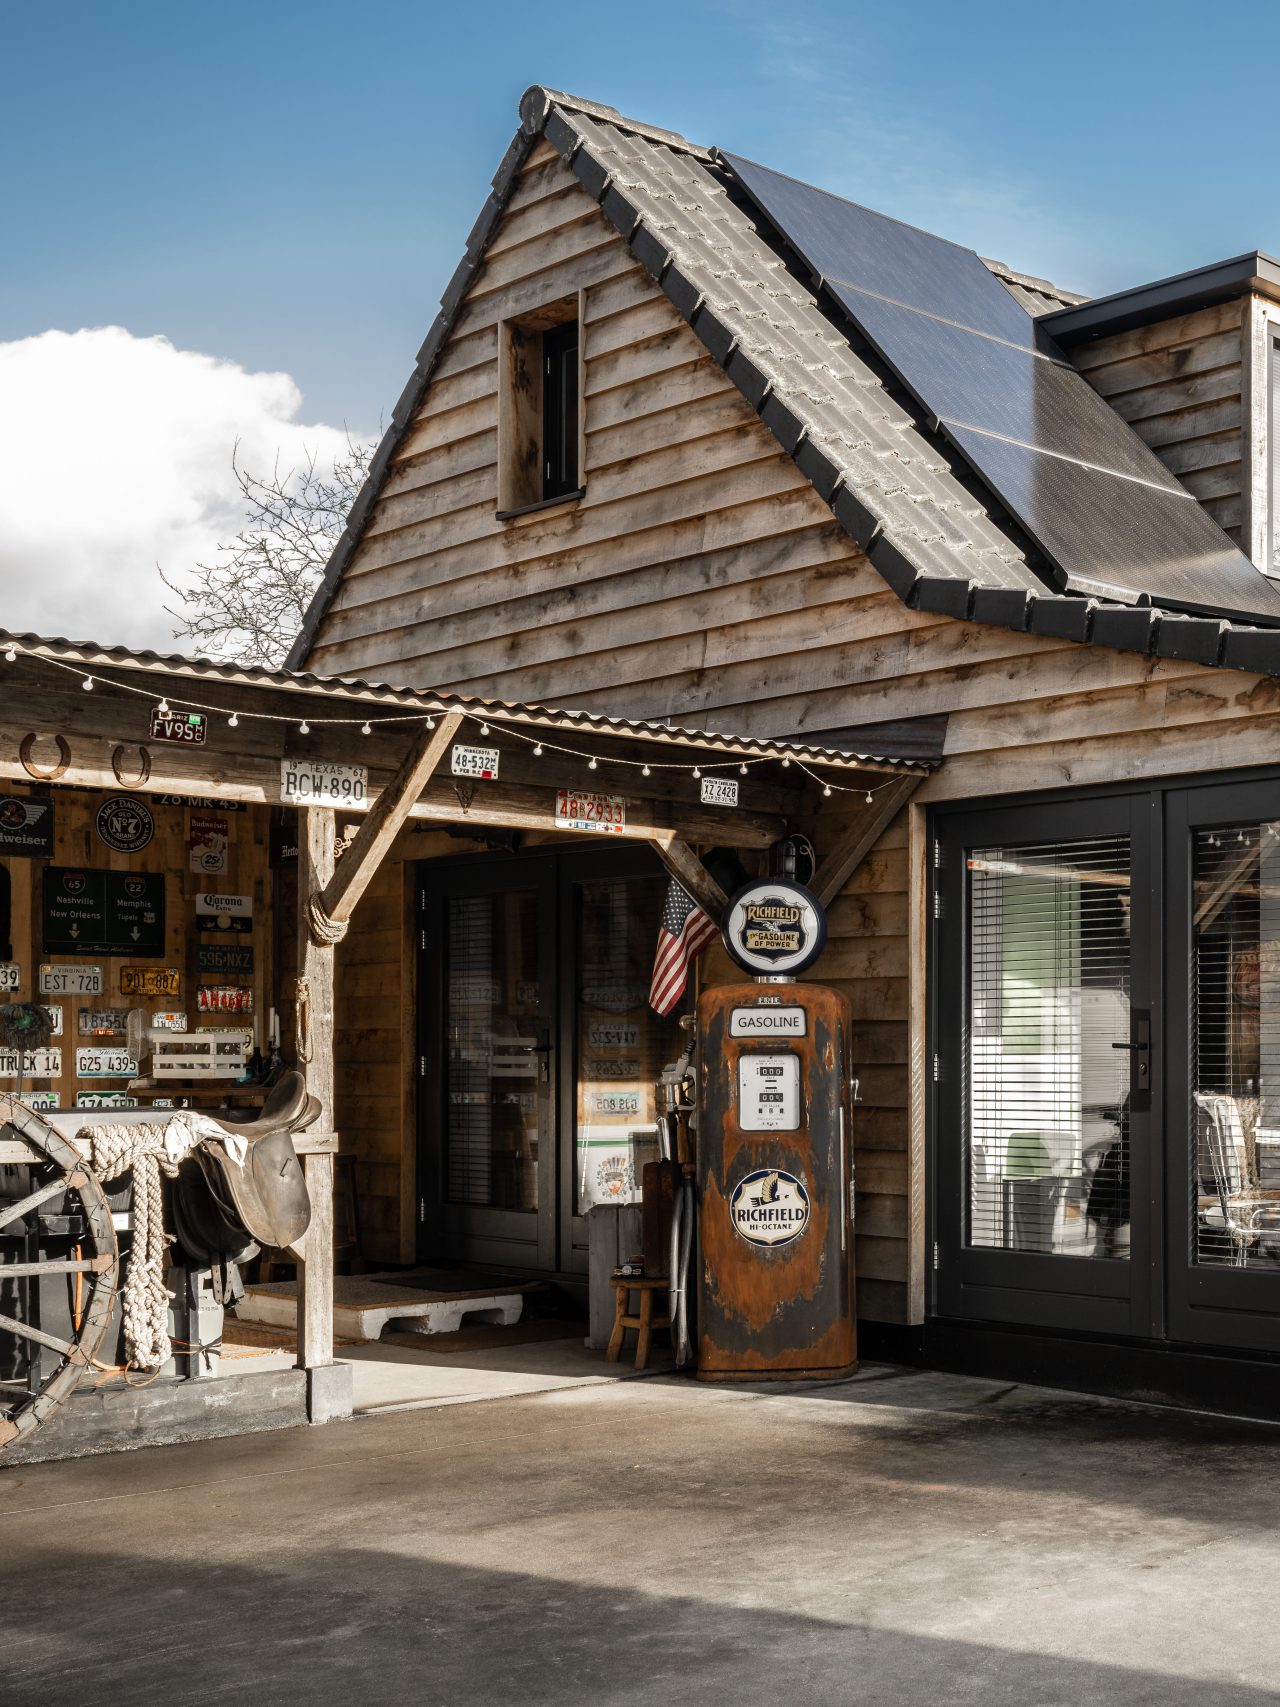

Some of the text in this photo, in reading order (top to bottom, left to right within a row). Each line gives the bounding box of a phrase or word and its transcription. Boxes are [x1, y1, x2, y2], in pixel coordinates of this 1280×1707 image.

[456, 753, 490, 769] 48-532
[309, 763, 344, 775] TEXAS
[704, 784, 736, 798] XZ 2428
[101, 802, 118, 820] JACK
[191, 819, 227, 829] Budweiser
[68, 880, 80, 888] 65
[129, 884, 142, 892] 22
[56, 896, 94, 905] Nashville
[117, 899, 152, 908] Memphis
[203, 894, 243, 908] Corona
[50, 909, 101, 920] New Orleans
[747, 906, 800, 921] RICHFIELD
[758, 932, 795, 942] GASOLINE
[765, 940, 791, 948] POWER
[758, 996, 780, 1004] ERIE
[738, 1016, 800, 1028] GASOLINE
[45, 1056, 59, 1071] 14
[79, 1057, 101, 1071] G25
[738, 1208, 805, 1221] RICHFIELD
